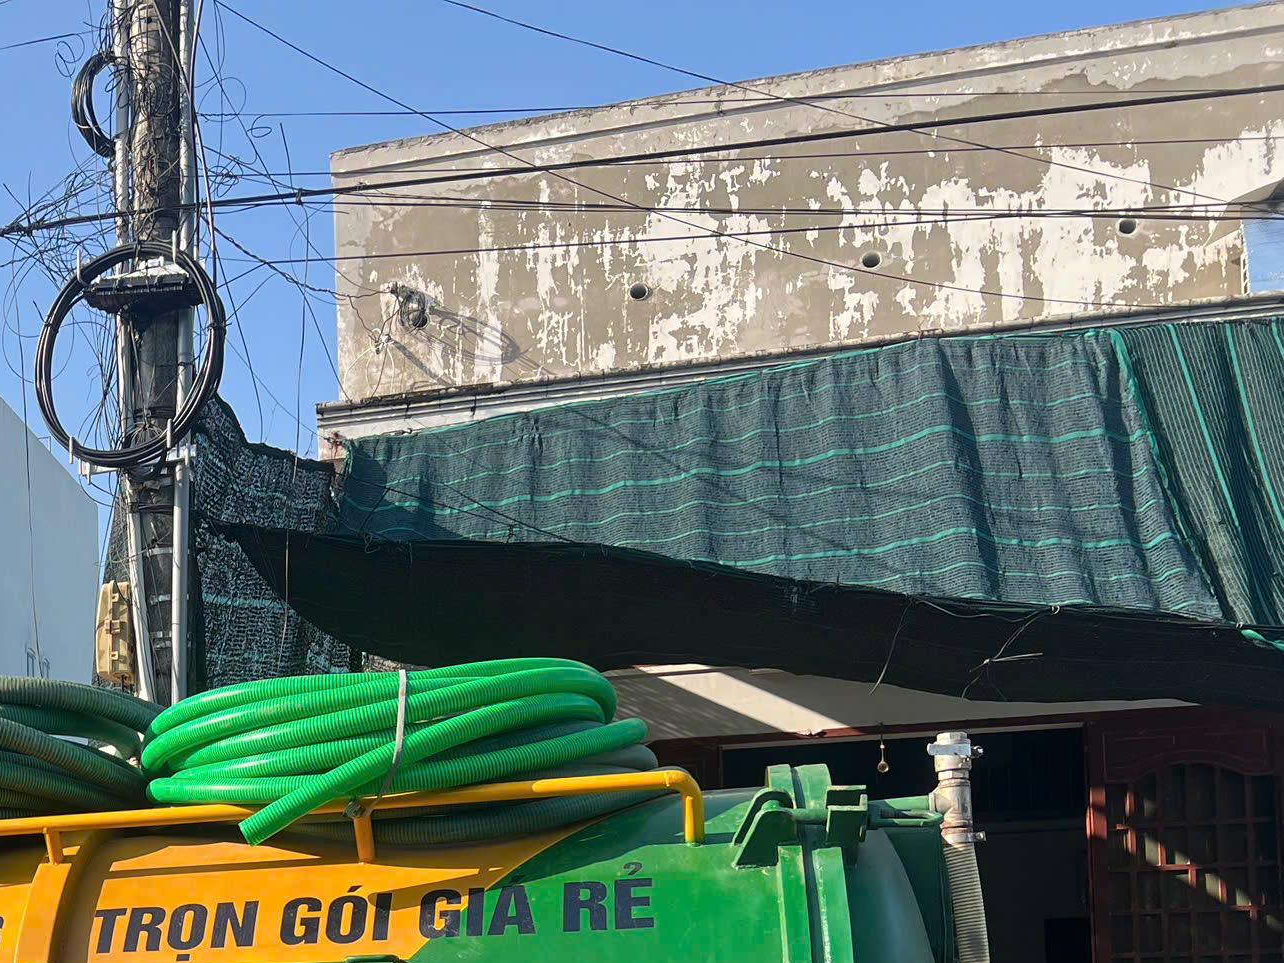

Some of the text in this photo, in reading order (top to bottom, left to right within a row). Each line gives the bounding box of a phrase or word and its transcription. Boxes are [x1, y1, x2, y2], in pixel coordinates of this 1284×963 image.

[94, 862, 655, 961] TRỌN GÓI GIÁ RẺ
